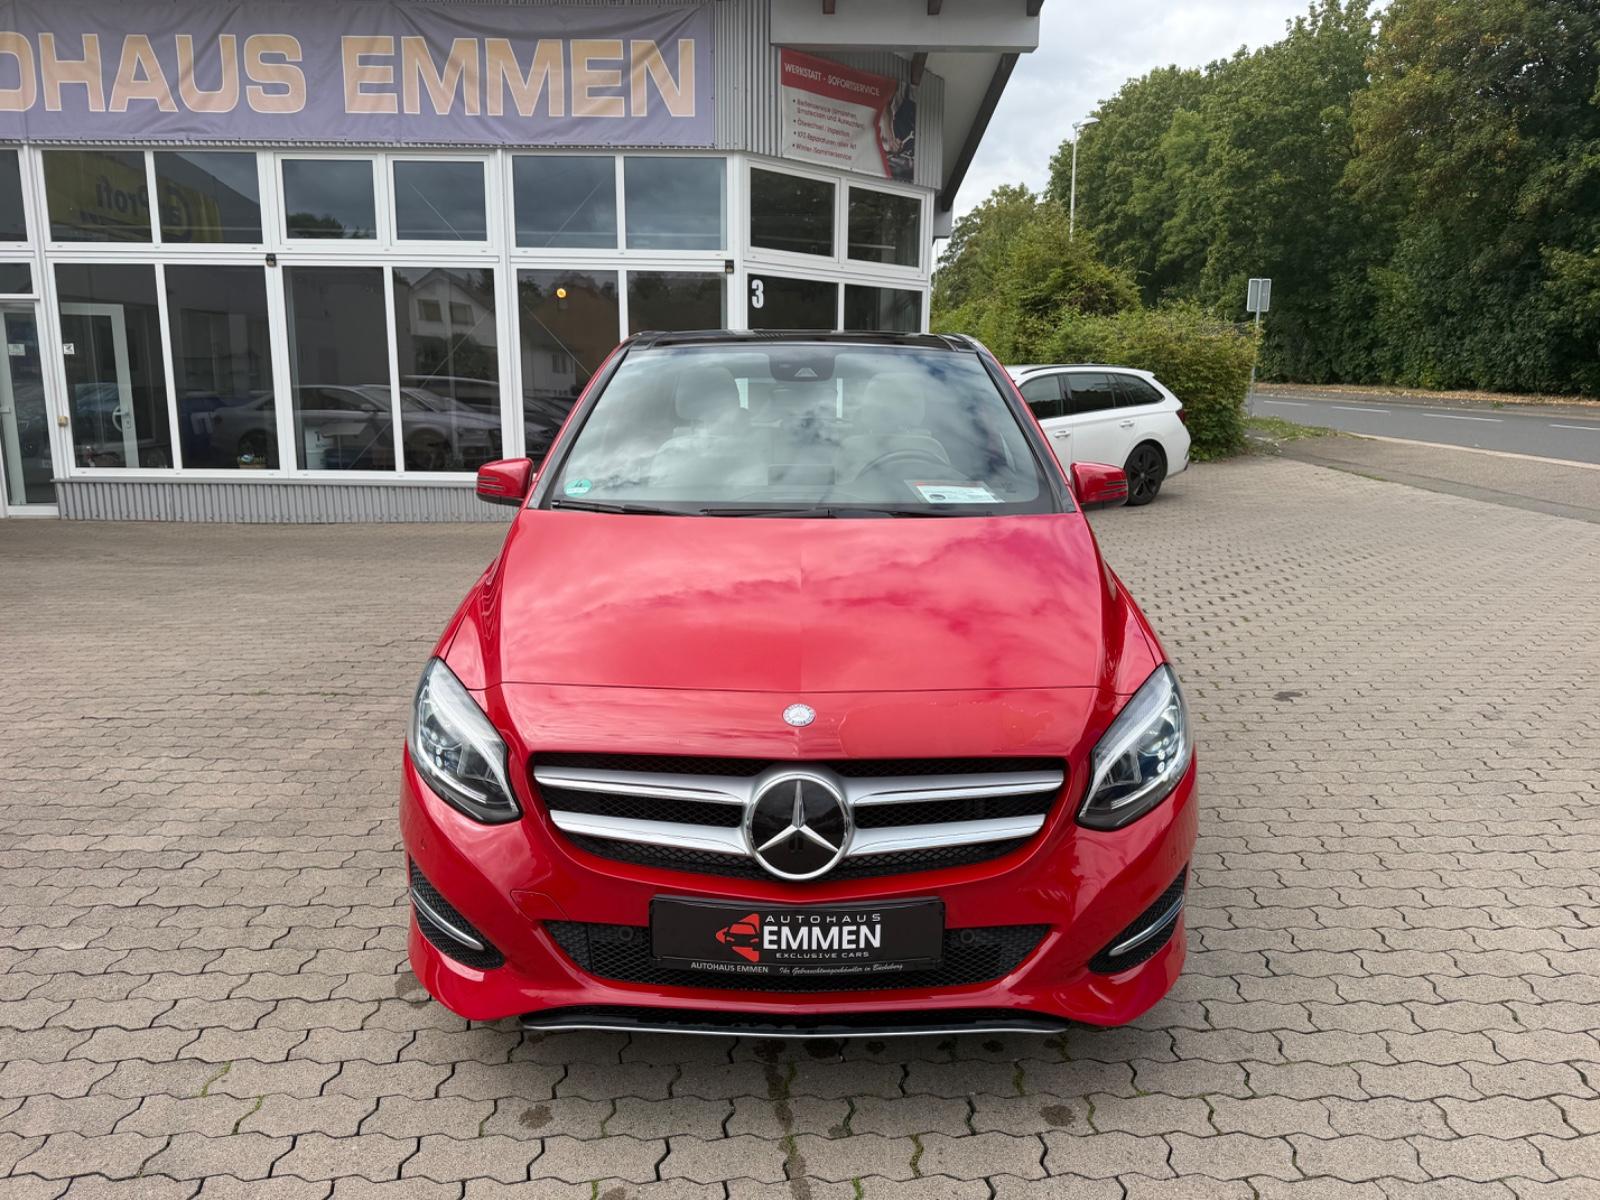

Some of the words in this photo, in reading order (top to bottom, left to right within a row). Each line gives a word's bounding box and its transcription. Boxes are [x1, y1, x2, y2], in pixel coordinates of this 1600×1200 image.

[341, 35, 695, 118] EMMEN
[784, 62, 822, 80] WERKSTATT
[828, 75, 880, 97] SOFORTSERVICE
[752, 279, 764, 308] 3
[765, 913, 881, 923] AUTOHAUS
[763, 924, 881, 950] EMMEN
[691, 962, 735, 972] AUTOHAUS
[737, 965, 769, 973] EMMEN
